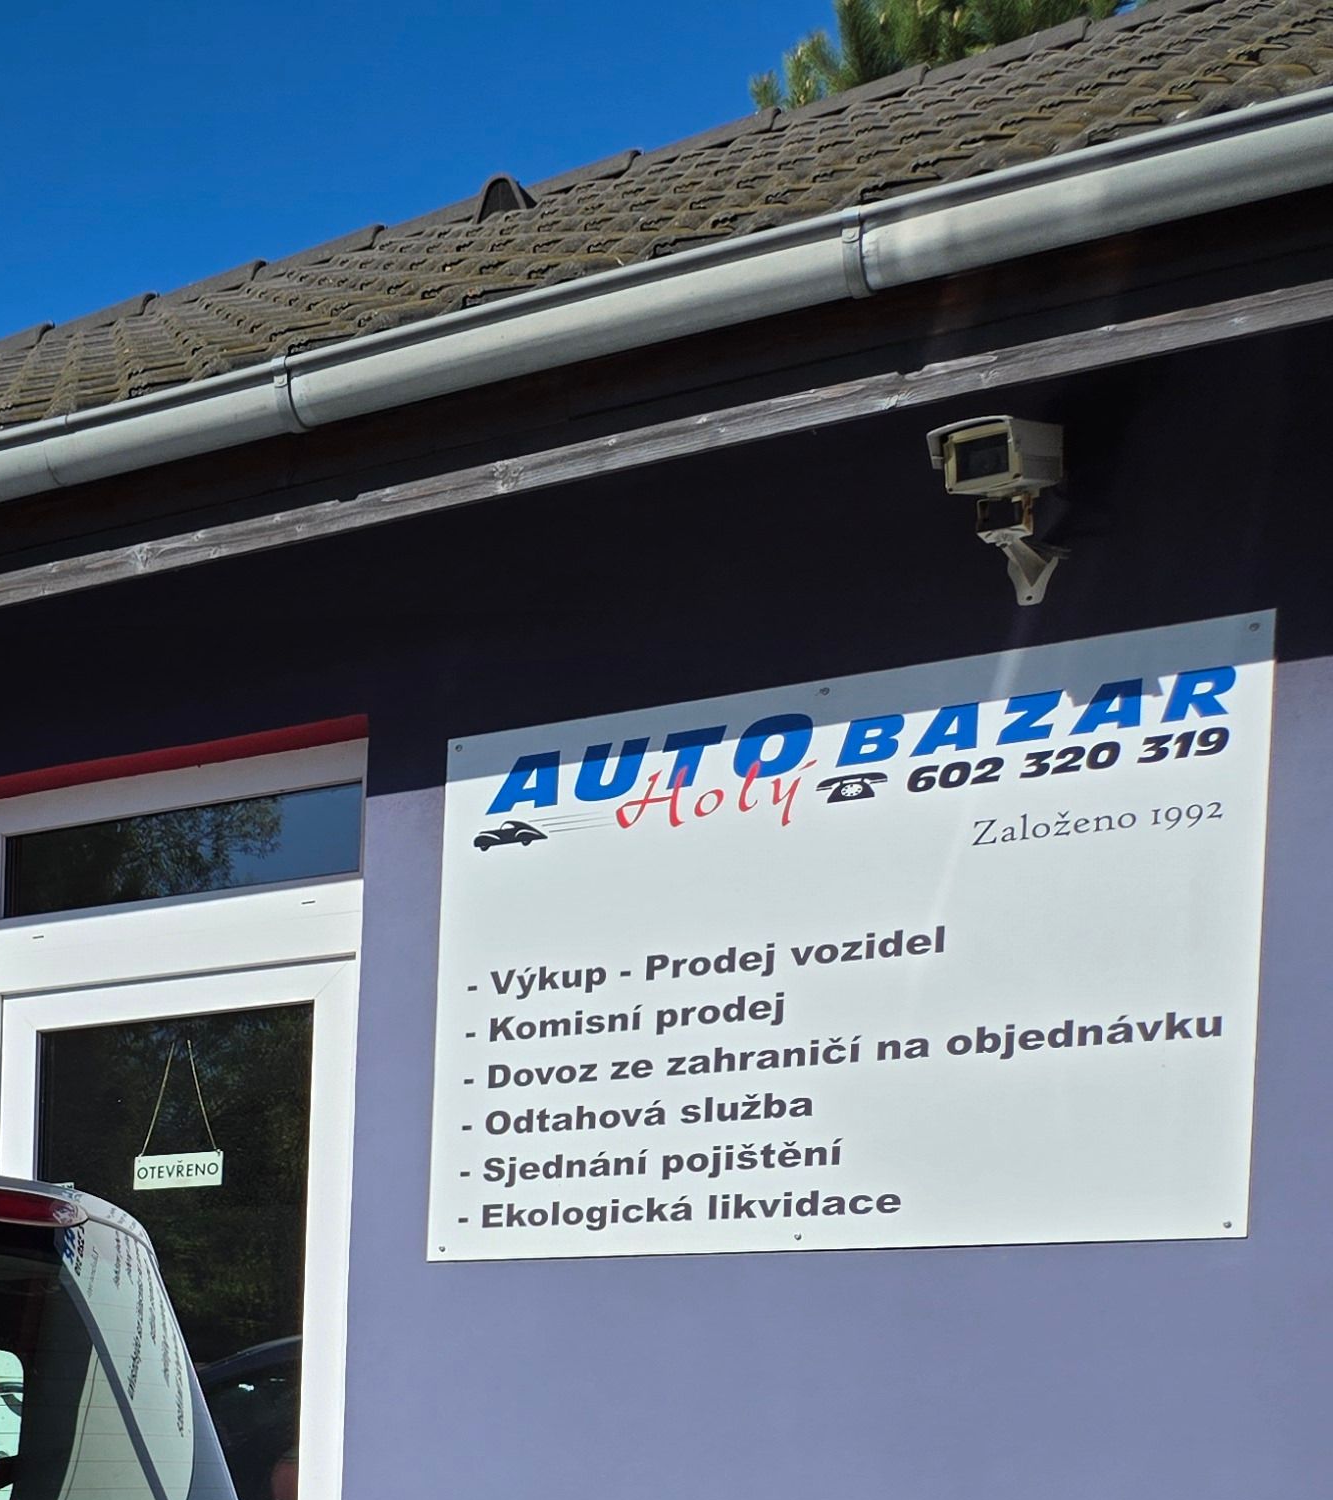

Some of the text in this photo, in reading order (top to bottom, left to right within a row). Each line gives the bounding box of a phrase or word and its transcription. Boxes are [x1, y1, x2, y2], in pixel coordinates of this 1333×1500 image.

[906, 726, 1231, 793] 602 320 319
[615, 758, 818, 829] Holý
[971, 801, 1224, 847] Založeno 1992
[490, 965, 607, 1000] Výkup
[645, 942, 775, 981] Prodej
[790, 925, 946, 966] vozidel
[489, 1004, 641, 1043] Komisní
[655, 991, 785, 1036] prodej
[487, 1063, 598, 1089] Dovoz
[610, 1059, 654, 1081] ze
[666, 1035, 862, 1079] zahraničí
[876, 1037, 929, 1061] na
[946, 1011, 1223, 1056] objednávku
[485, 1099, 666, 1135] Odtahová
[680, 1092, 813, 1124] služba
[137, 1160, 219, 1180] OTEVŘENO
[482, 1148, 649, 1188] Sjednání
[661, 1137, 843, 1181] pojištění
[481, 1195, 692, 1231] Ekologická
[708, 1189, 902, 1222] likvidace
